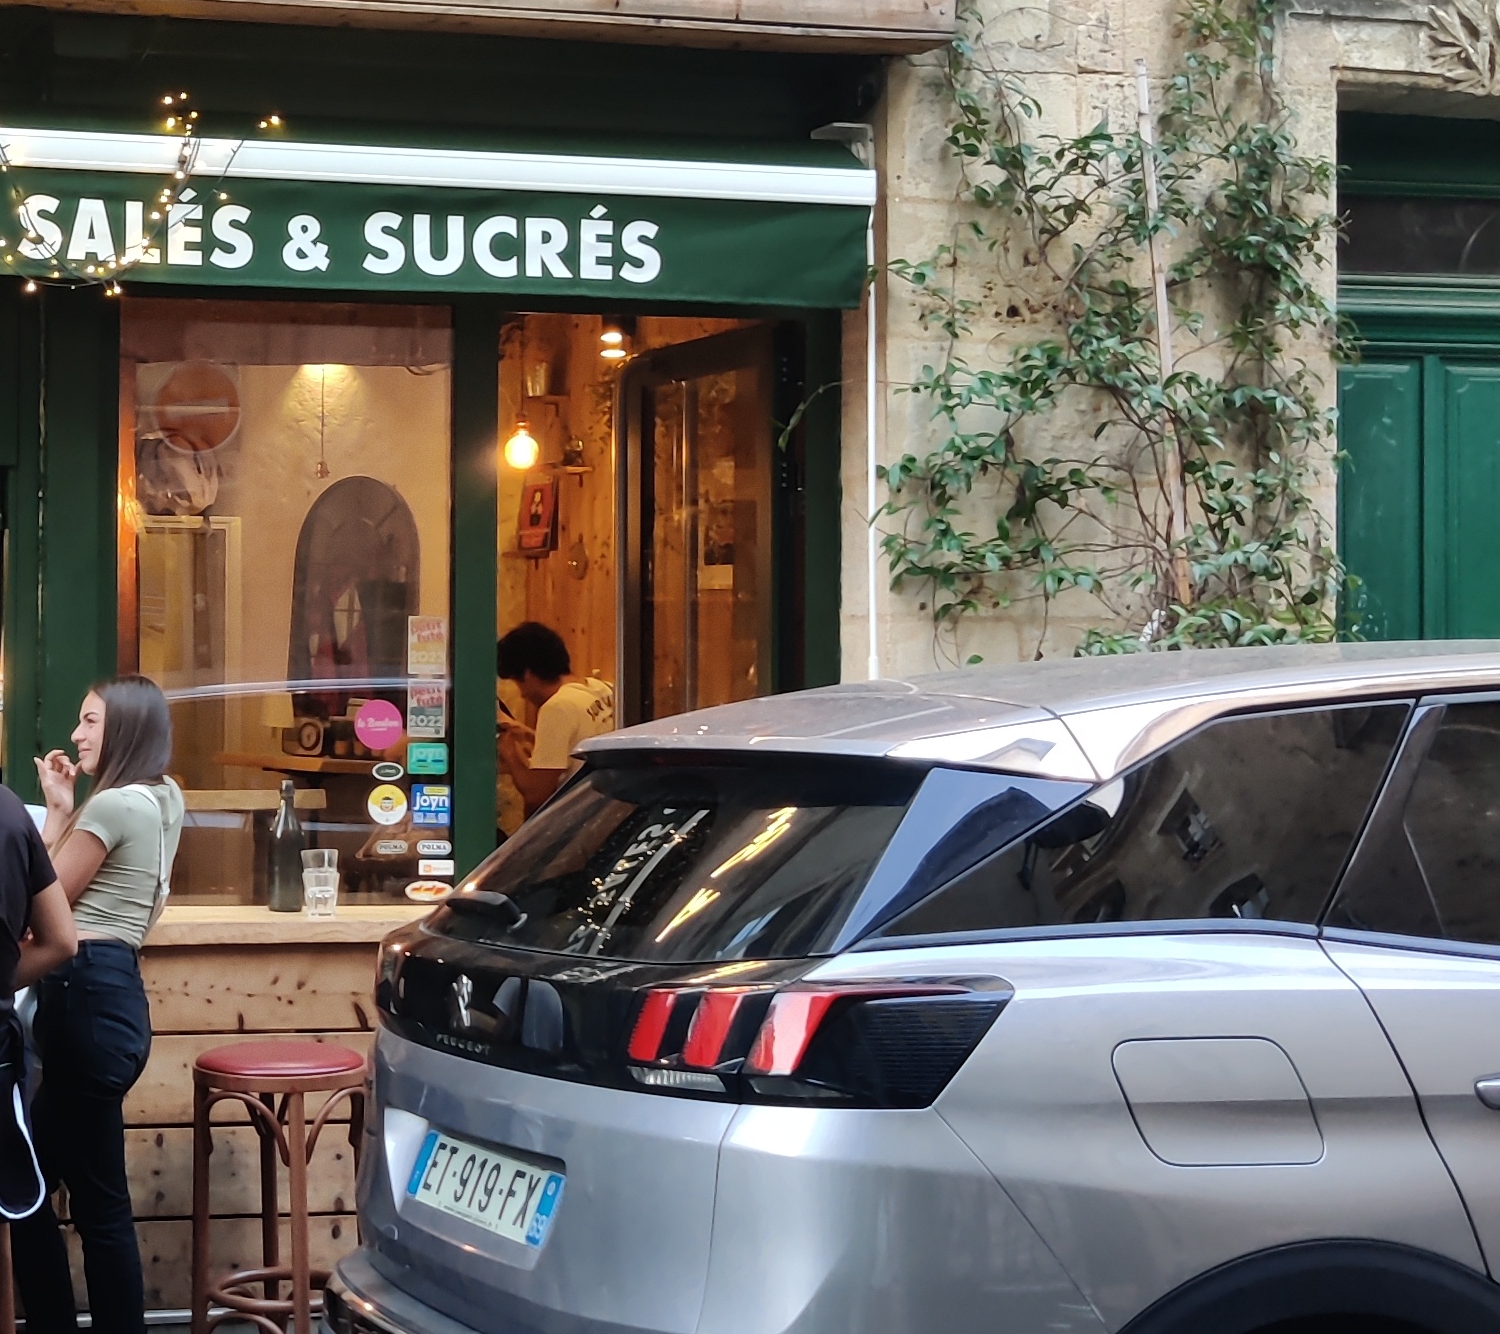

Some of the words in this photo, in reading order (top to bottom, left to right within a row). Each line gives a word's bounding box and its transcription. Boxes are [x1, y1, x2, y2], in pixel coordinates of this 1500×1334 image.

[16, 187, 256, 270] SALÉS
[281, 213, 330, 272] &
[362, 204, 662, 283] SUCRÉS
[410, 715, 443, 727] 2022
[413, 792, 448, 811] joyn
[436, 1033, 490, 1056] PEUGEOT
[422, 1142, 541, 1229] ET-919-FX
